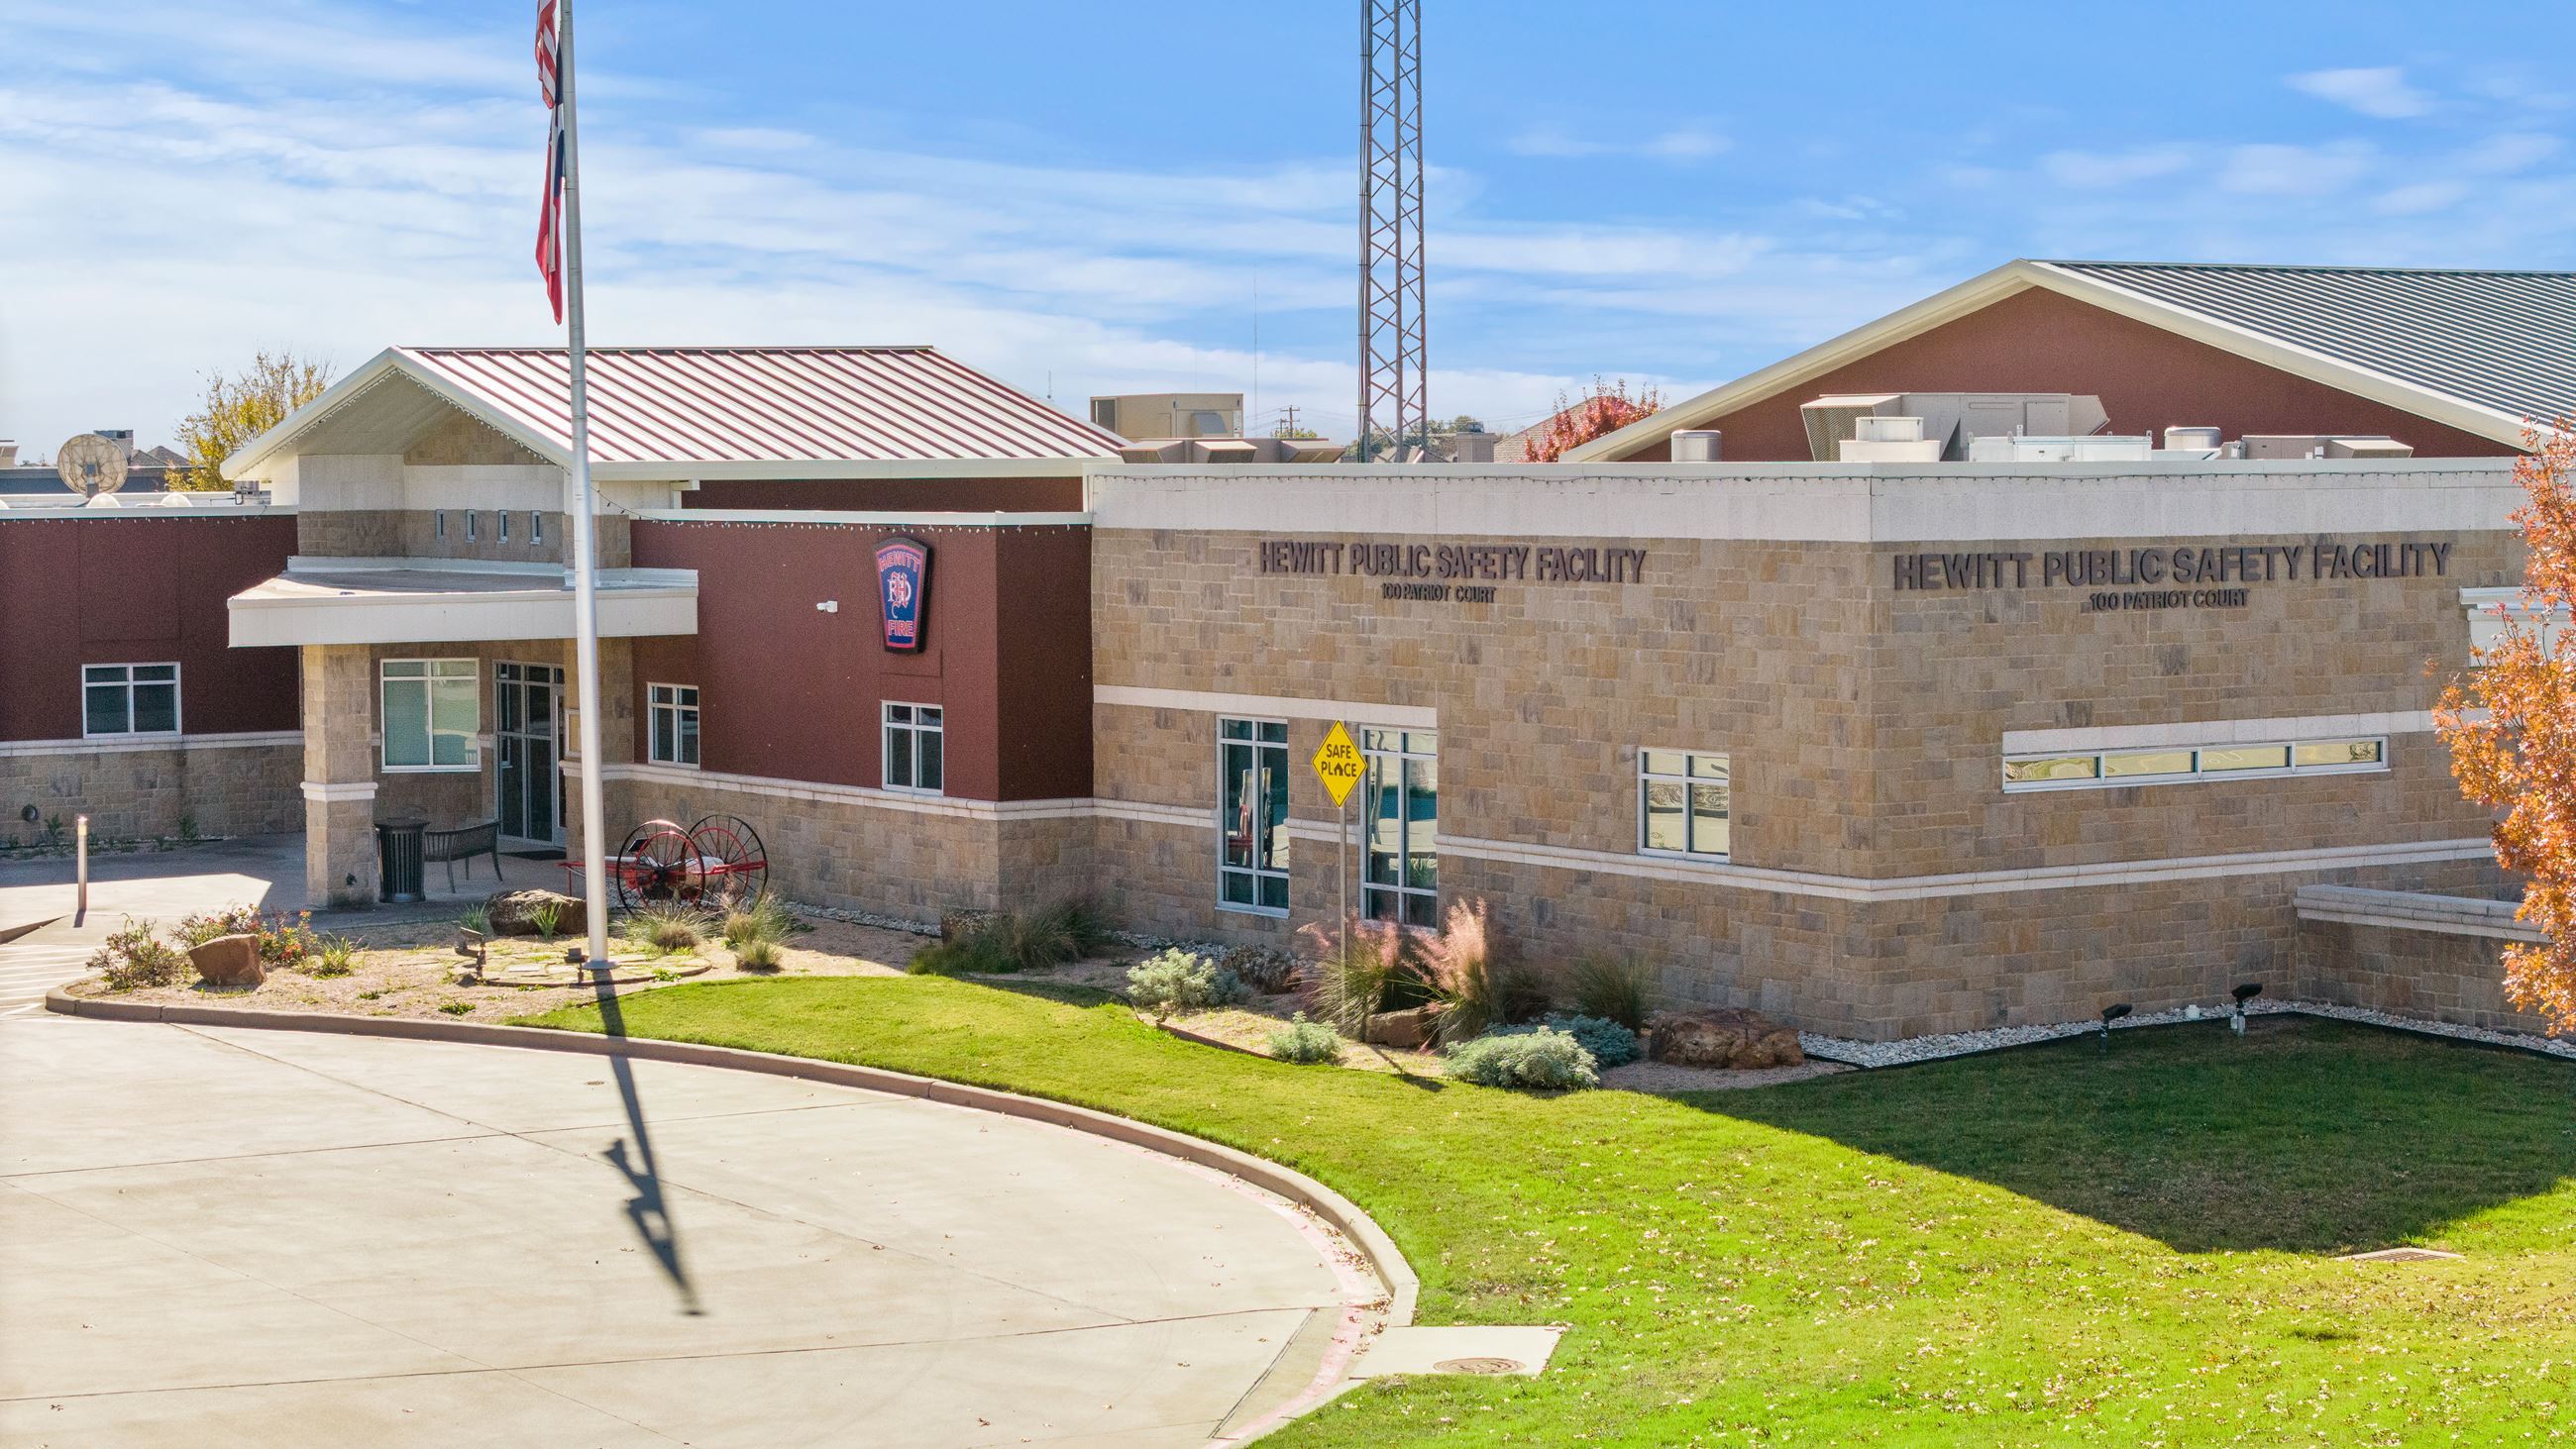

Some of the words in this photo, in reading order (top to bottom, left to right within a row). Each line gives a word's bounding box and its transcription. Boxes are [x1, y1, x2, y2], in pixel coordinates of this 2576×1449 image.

[879, 551, 920, 571] HEWITT
[1259, 541, 1343, 574] HEWITT
[1349, 544, 1431, 577] PUBLIC
[1436, 546, 1530, 580] SAFETY
[1536, 547, 1648, 583] FACILITY
[1893, 552, 2034, 590] HEWITT
[2043, 549, 2164, 587] PUBLIC
[2173, 546, 2305, 583] SAFETY
[2313, 543, 2453, 579] FACILITY
[1380, 581, 1401, 600] 100
[1402, 582, 1451, 602] PATRIOT
[1454, 584, 1497, 603] COURT
[2089, 592, 2119, 611] 100
[2122, 589, 2192, 610] PATRIOT
[2193, 587, 2250, 608] COURT
[888, 620, 914, 637] FIRE
[1326, 744, 1351, 759] SAFE
